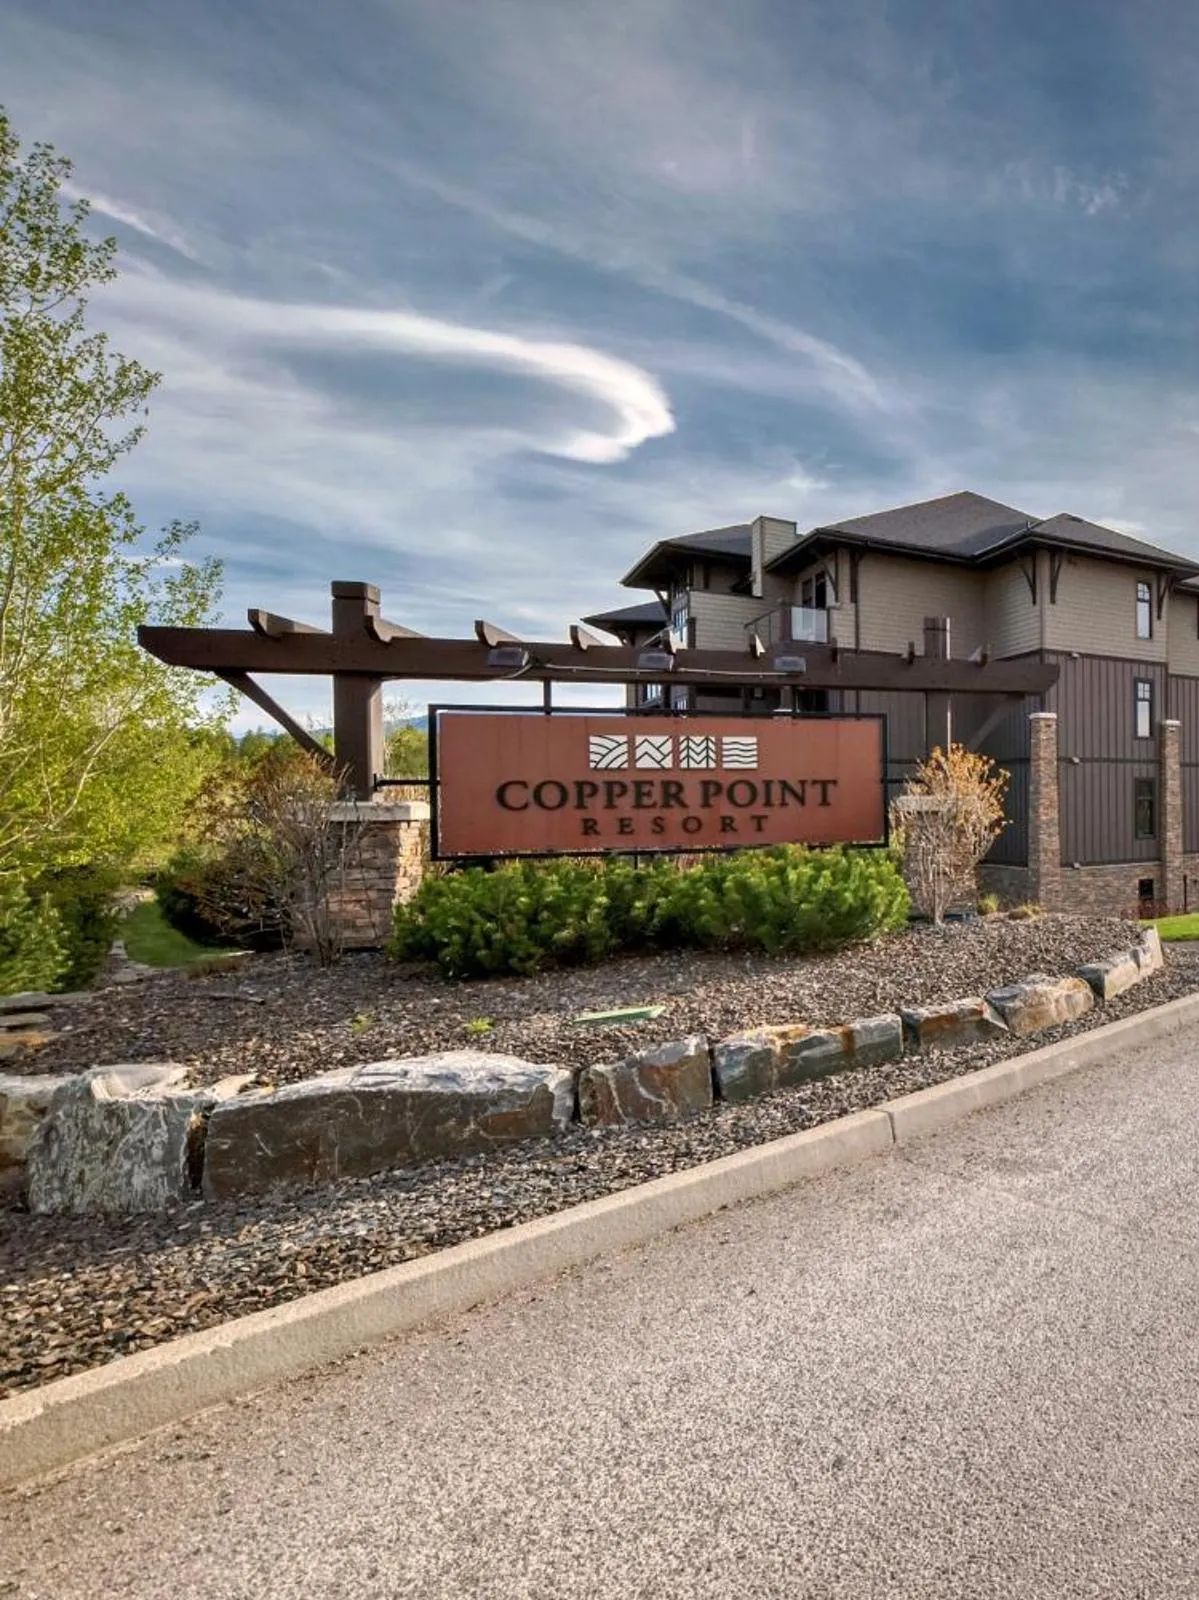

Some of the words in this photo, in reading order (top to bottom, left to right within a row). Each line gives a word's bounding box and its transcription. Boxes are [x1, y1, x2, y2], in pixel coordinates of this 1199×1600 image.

[496, 779, 689, 811] COPPER
[701, 778, 837, 807] POINT
[582, 815, 769, 836] RESORT
